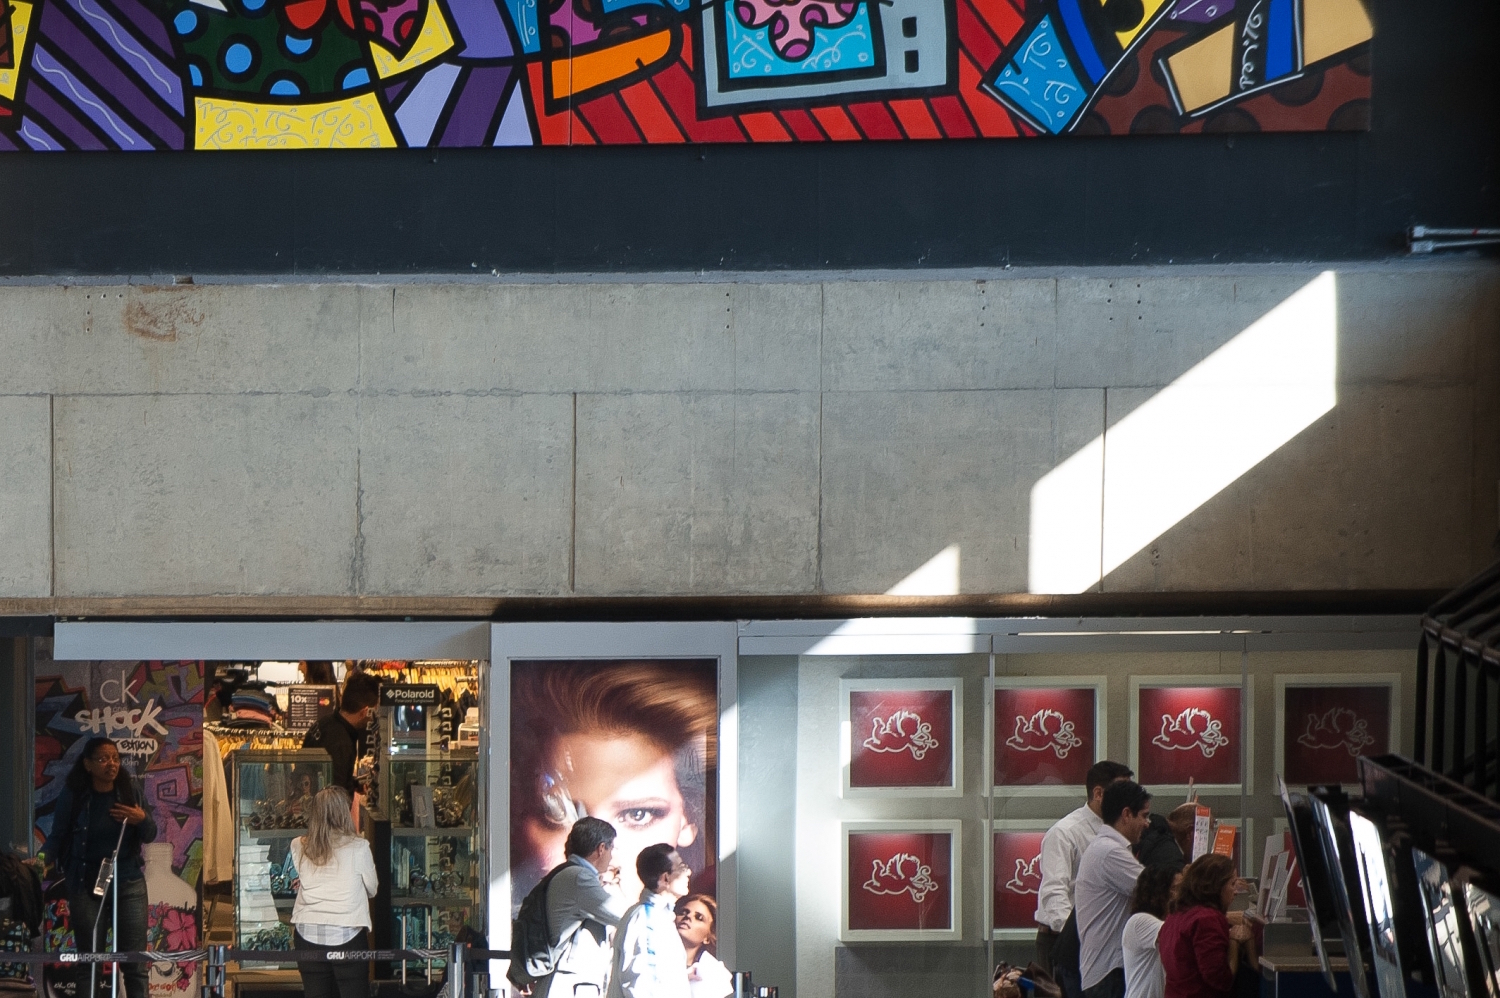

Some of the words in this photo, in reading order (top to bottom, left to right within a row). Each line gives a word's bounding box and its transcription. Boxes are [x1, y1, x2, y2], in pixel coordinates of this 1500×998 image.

[100, 670, 140, 704] ck
[394, 689, 435, 699] Polaroid
[75, 698, 169, 738] SHOCK
